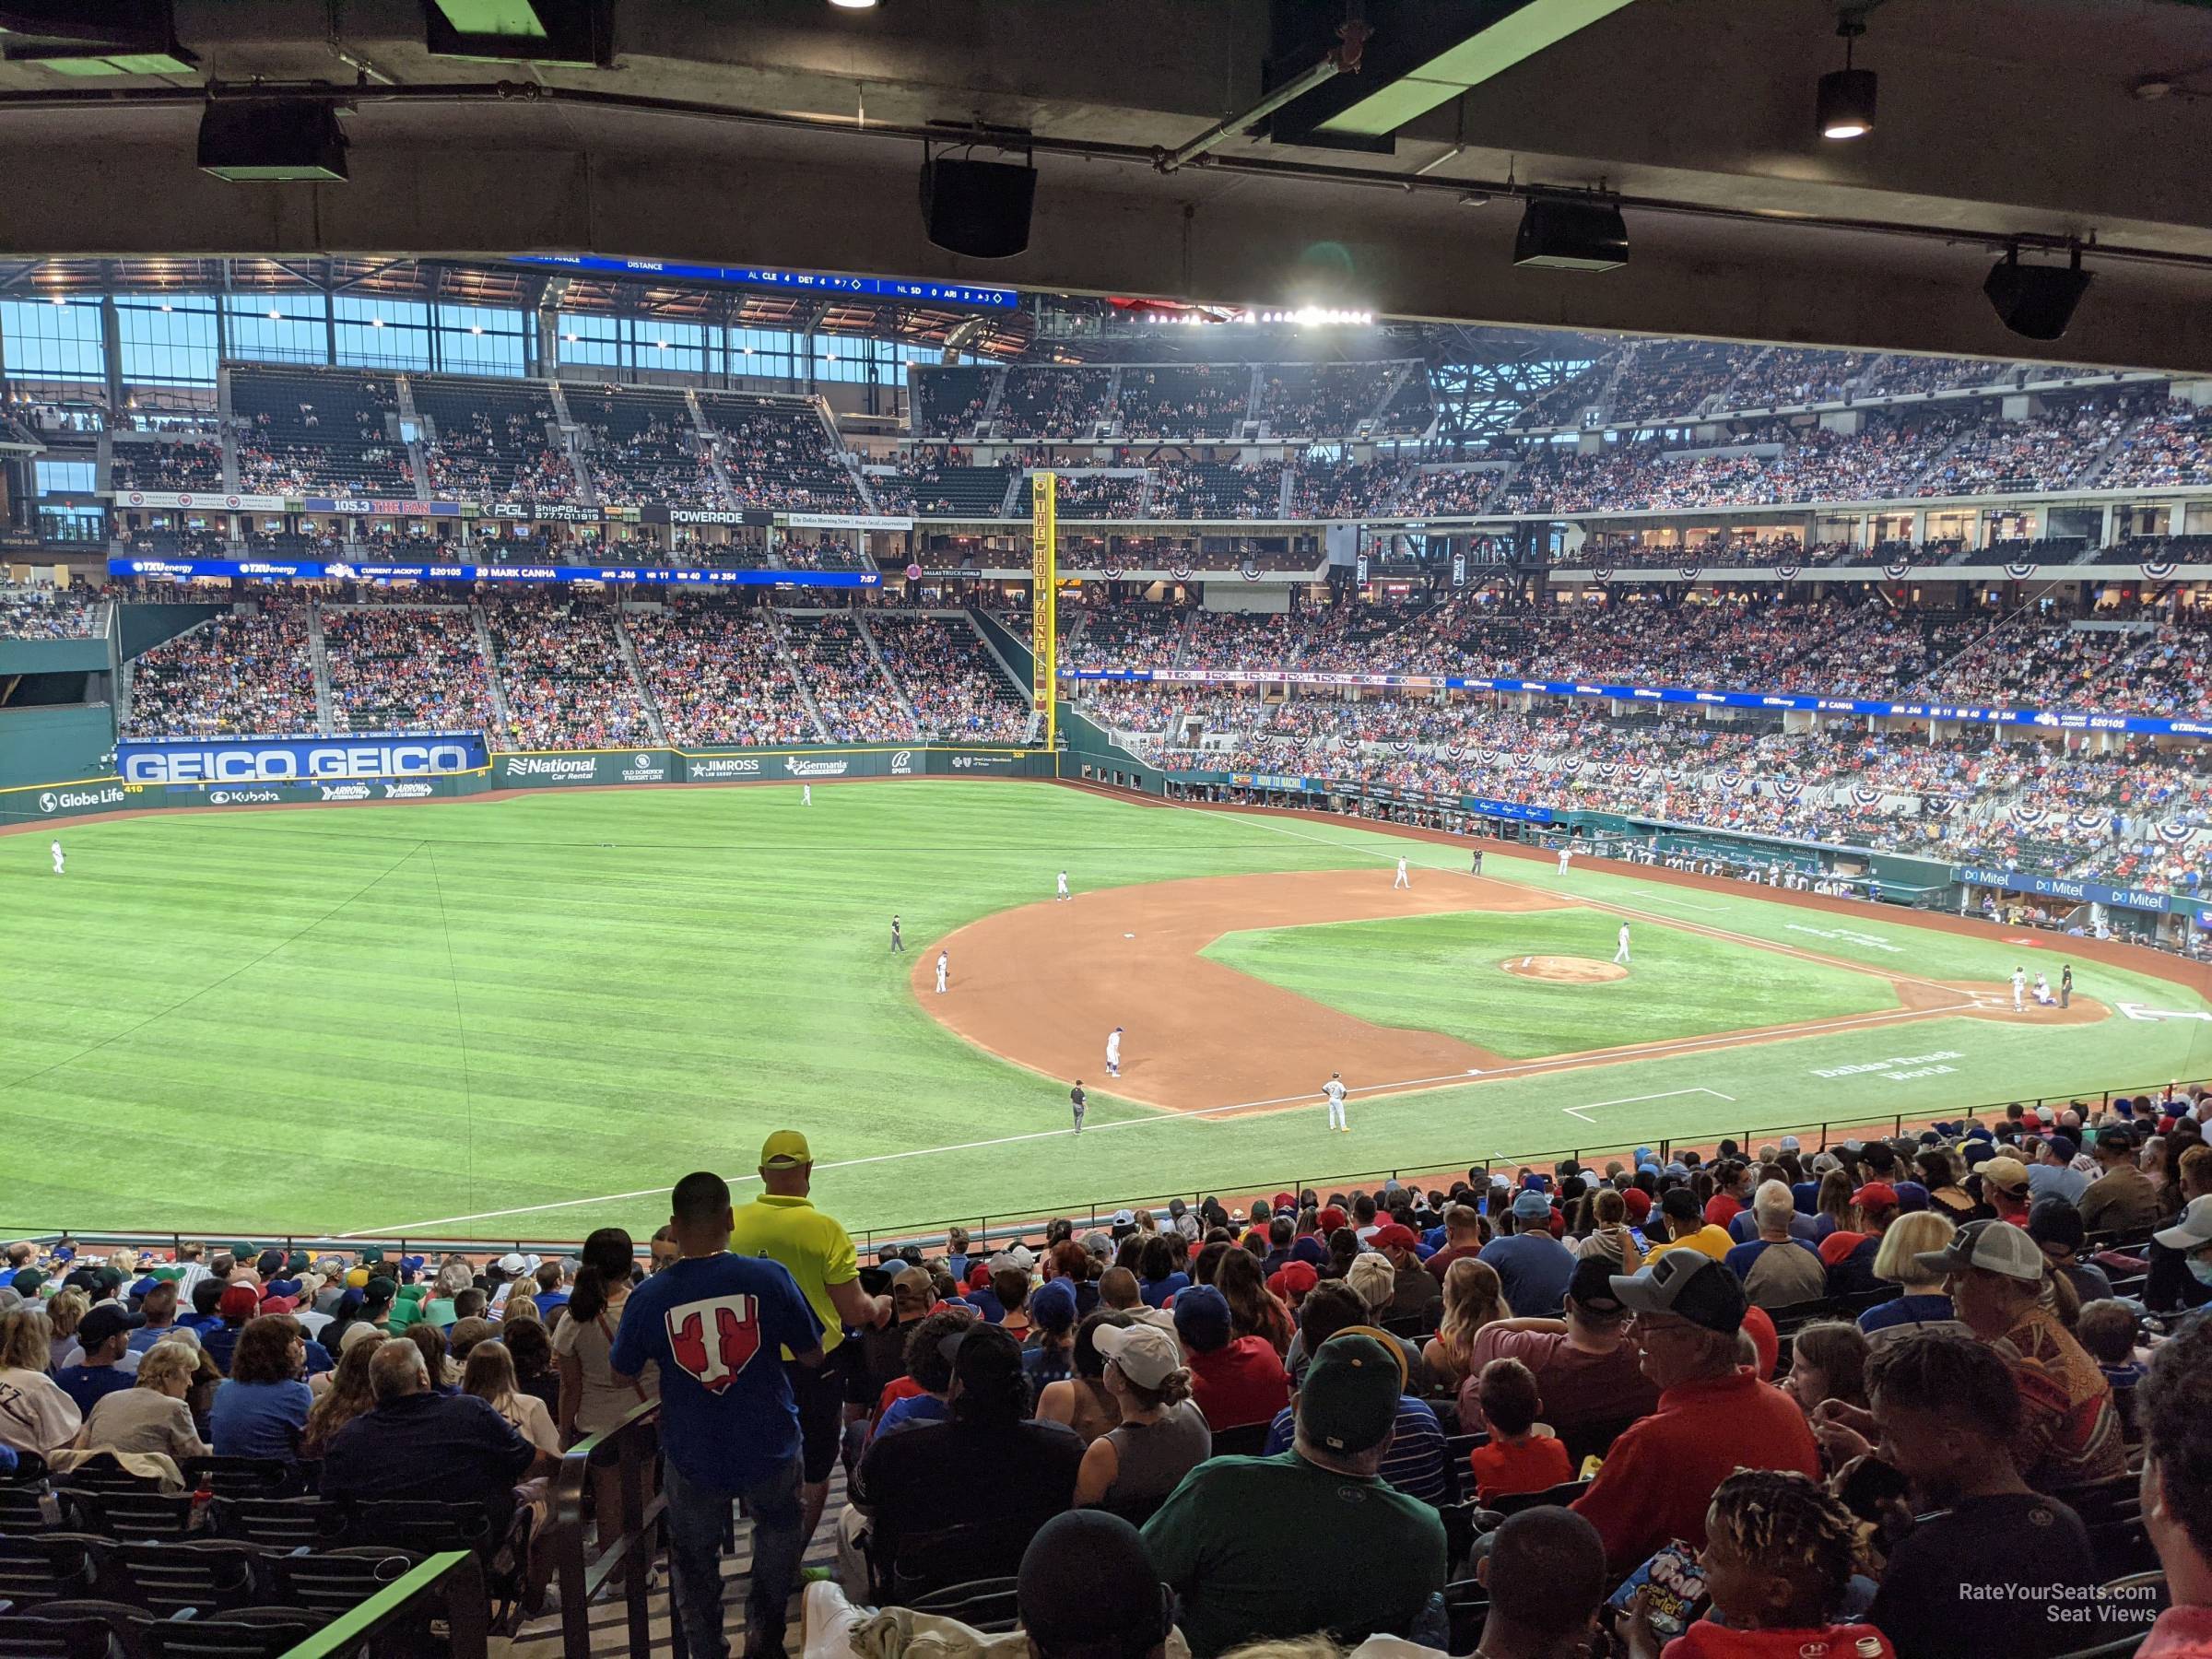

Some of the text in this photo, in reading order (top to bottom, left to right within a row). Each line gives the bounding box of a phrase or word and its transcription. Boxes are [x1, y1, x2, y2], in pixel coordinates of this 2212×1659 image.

[628, 261, 663, 271] DISTANCE
[748, 270, 759, 280] AL
[762, 272, 778, 281] CLE
[798, 276, 814, 284] DET
[820, 277, 826, 286] 4
[897, 285, 908, 294] NL
[911, 287, 922, 295] SD
[944, 288, 958, 299] ARI
[334, 500, 431, 515] 105.3 THE FAN
[494, 504, 528, 516] PGL
[535, 504, 599, 514] ShipPGL.com
[535, 512, 599, 521] 877.701.1919
[670, 510, 743, 524] POWERADE
[1036, 500, 1045, 539] THE
[393, 568, 423, 576] JACKPOT
[430, 568, 462, 577] $20105
[476, 568, 556, 579] 20 MARK CANHA
[618, 571, 636, 580] .246
[659, 572, 669, 581] 11
[689, 572, 700, 581] 40
[721, 572, 736, 582] 354
[1036, 550, 1046, 589] HOT
[860, 574, 877, 584] 7:57
[1037, 601, 1045, 652] ZONE
[1829, 701, 1853, 711] CANHA
[1943, 708, 1951, 716] 11
[2000, 712, 2016, 721] 354
[2090, 719, 2125, 729] $20105
[125, 746, 466, 783] GEICO GEICO
[802, 759, 848, 771] Germania
[396, 783, 426, 794] ARROW
[1256, 775, 1271, 786] HOW
[1272, 776, 1280, 787] TO
[1281, 776, 1300, 788] NACHO
[335, 784, 365, 795] ARROW
[59, 788, 124, 807] Globe Life
[231, 791, 280, 803] Kubota
[1980, 871, 2009, 887] Mitel
[2052, 882, 2083, 897] Mitel
[2129, 891, 2163, 909] Mitel
[1809, 1050, 1966, 1078] Dallas Truck
[1878, 1064, 1959, 1081] World
[670, 1294, 747, 1382] T
